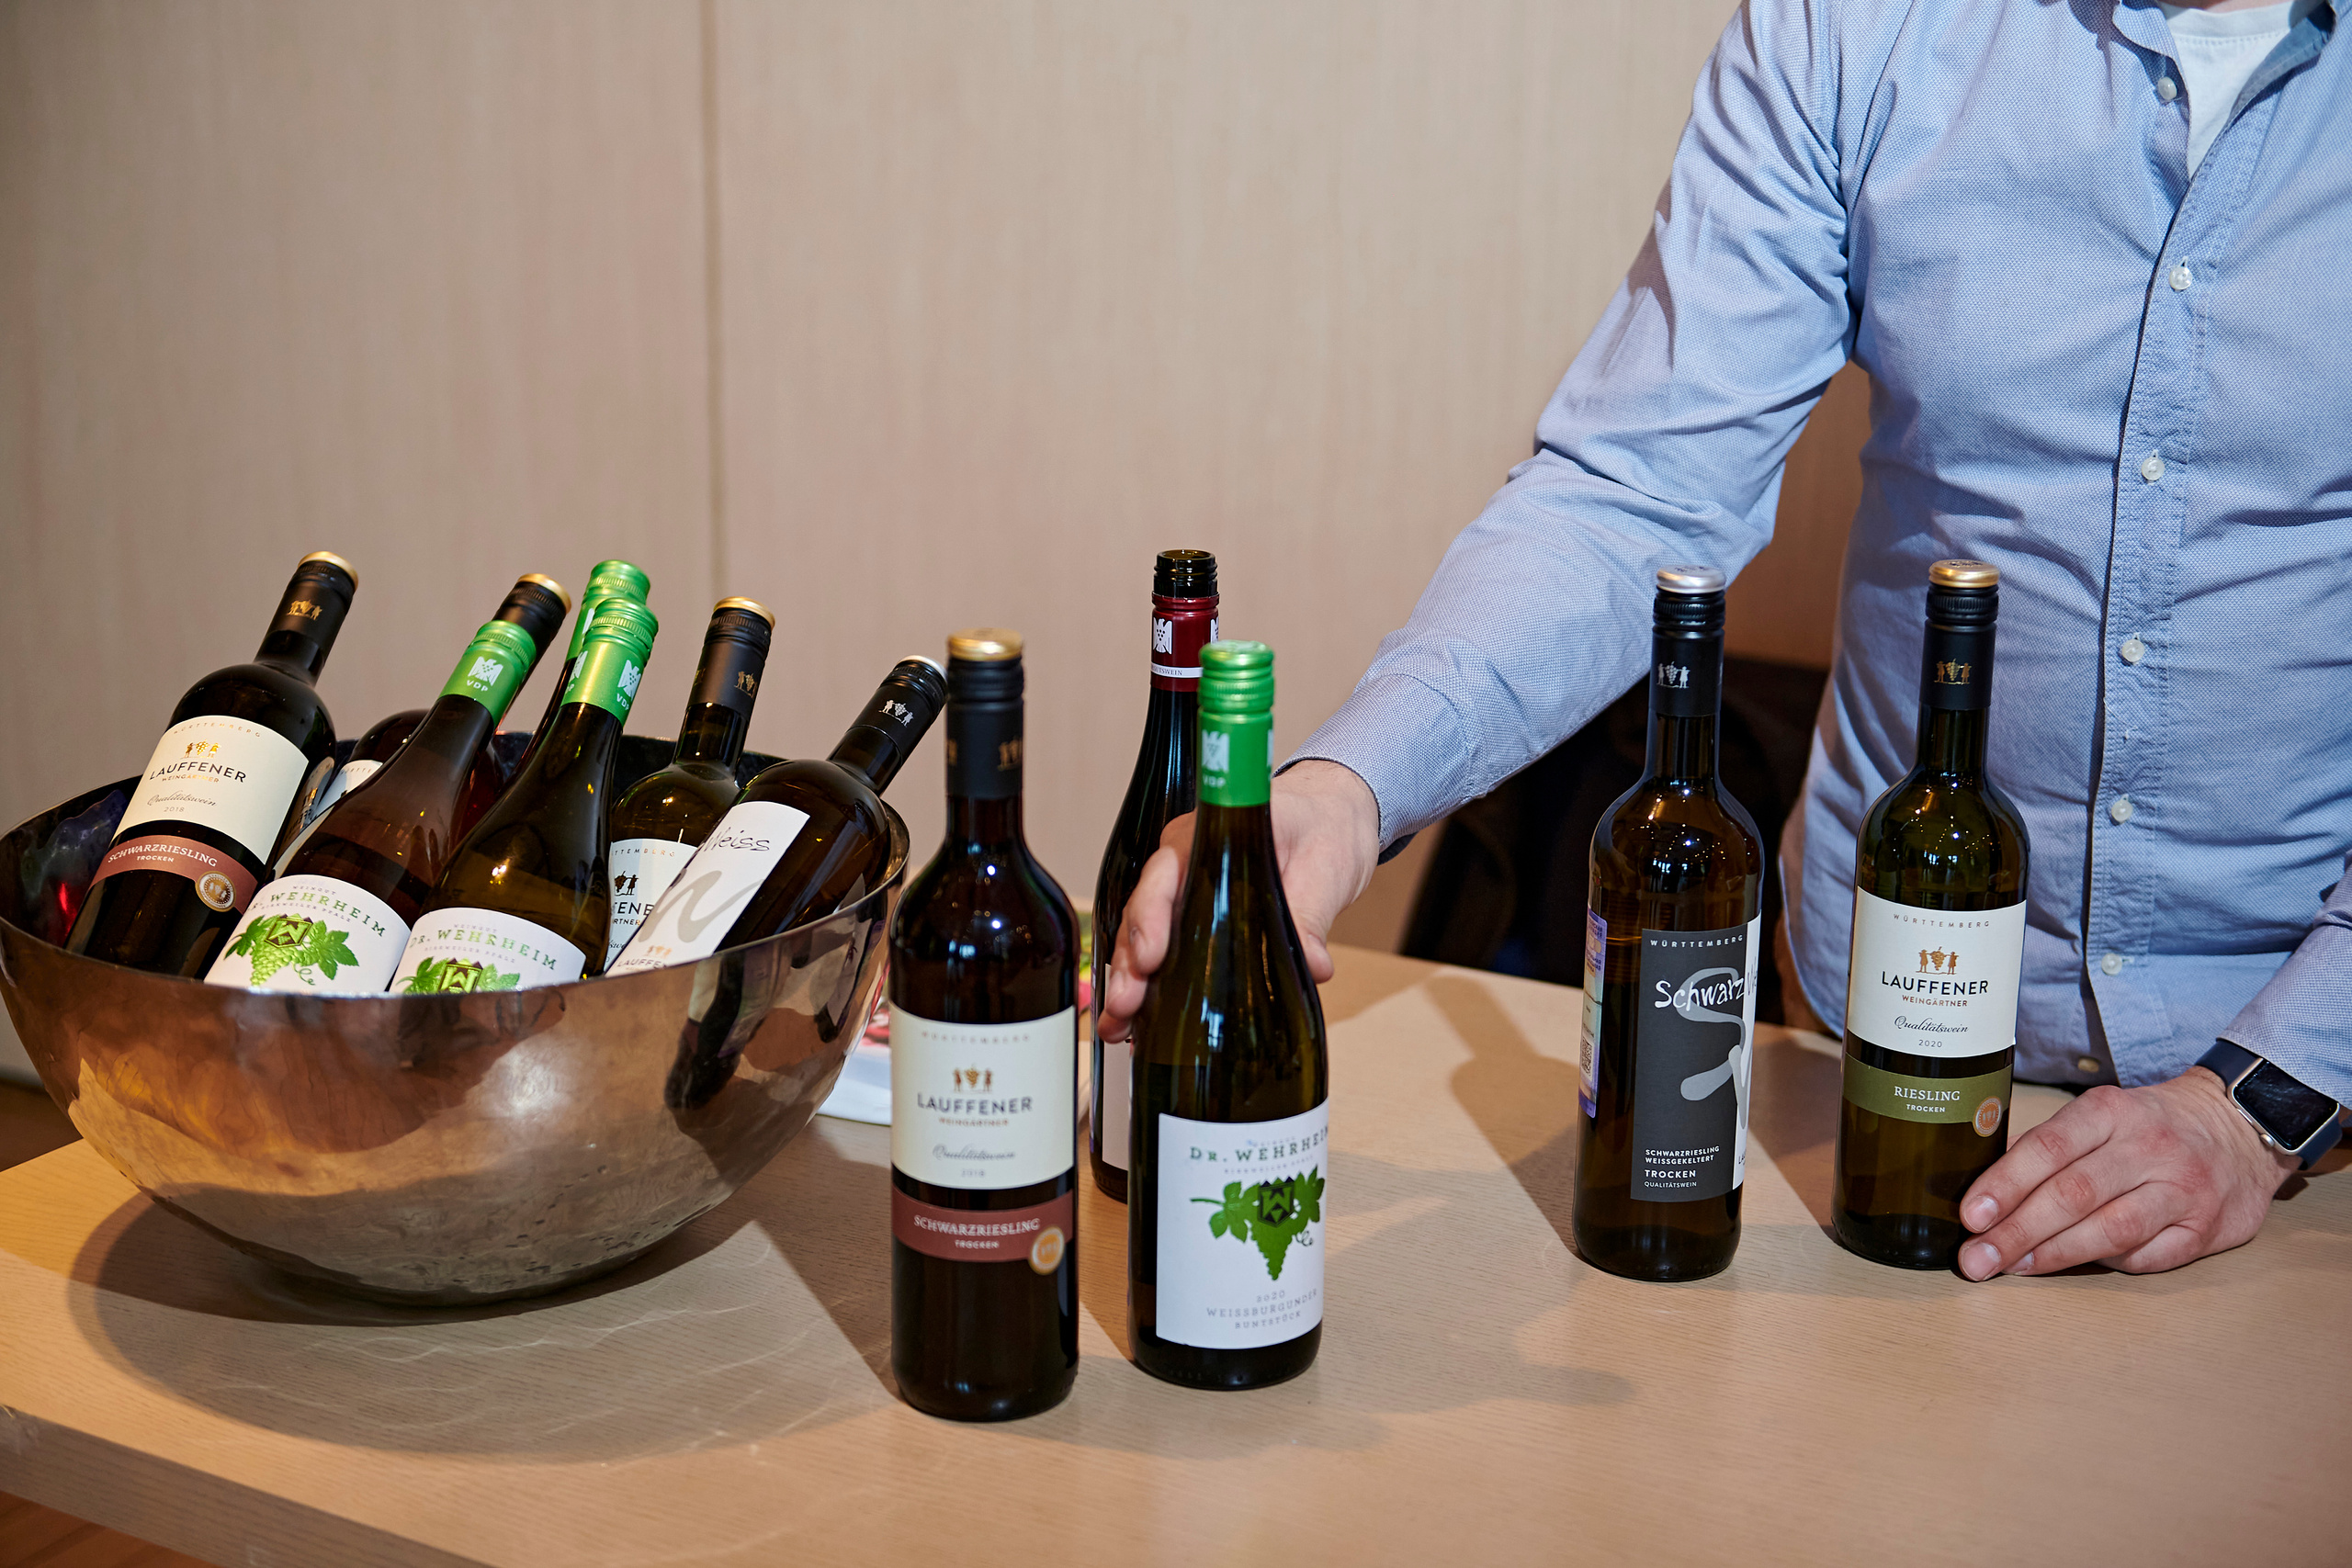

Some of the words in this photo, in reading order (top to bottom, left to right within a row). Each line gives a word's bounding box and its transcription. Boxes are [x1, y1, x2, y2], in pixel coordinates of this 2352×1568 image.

[466, 679, 488, 693] VDP
[174, 722, 260, 738] WÜRTTEMBERG
[150, 761, 246, 783] LAUFFENER
[1203, 774, 1226, 788] VDP
[147, 790, 217, 807] Qualitätswein
[107, 843, 218, 867] SCHWARZRIESLING
[612, 848, 675, 857] TTEMBERG
[293, 886, 337, 896] WEINGUT
[270, 892, 386, 937] WEHRHEIM
[1894, 913, 1990, 929] WÜRTTEMBERG
[1650, 934, 1743, 948] WÜRTTEMBERG
[437, 929, 557, 970] WEHRHEIM
[617, 958, 667, 969] LAUFFE
[1882, 971, 1988, 996] LAUFFENER
[1655, 977, 1745, 1011] Schwarz
[1902, 994, 1968, 1007] WEINGÄRTNER
[1894, 1015, 1969, 1033] Qualitätswein
[1918, 1039, 1943, 1048] 2020
[1894, 1086, 1961, 1101] RIESLING
[917, 1092, 1033, 1115] LAUFFENER
[1906, 1103, 1946, 1112] TROCKEN
[1645, 1145, 1720, 1156] SCHWARZRIESLING
[1645, 1155, 1713, 1165] WEISSGEKELTERT
[1645, 1169, 1696, 1179] TROCKEN
[913, 1214, 1041, 1236] SCHWARZRIESLING
[955, 1240, 1000, 1249] TROCKEN
[1206, 1289, 1317, 1317] WEISSBURGUNDER
[1257, 1290, 1285, 1303] 2020
